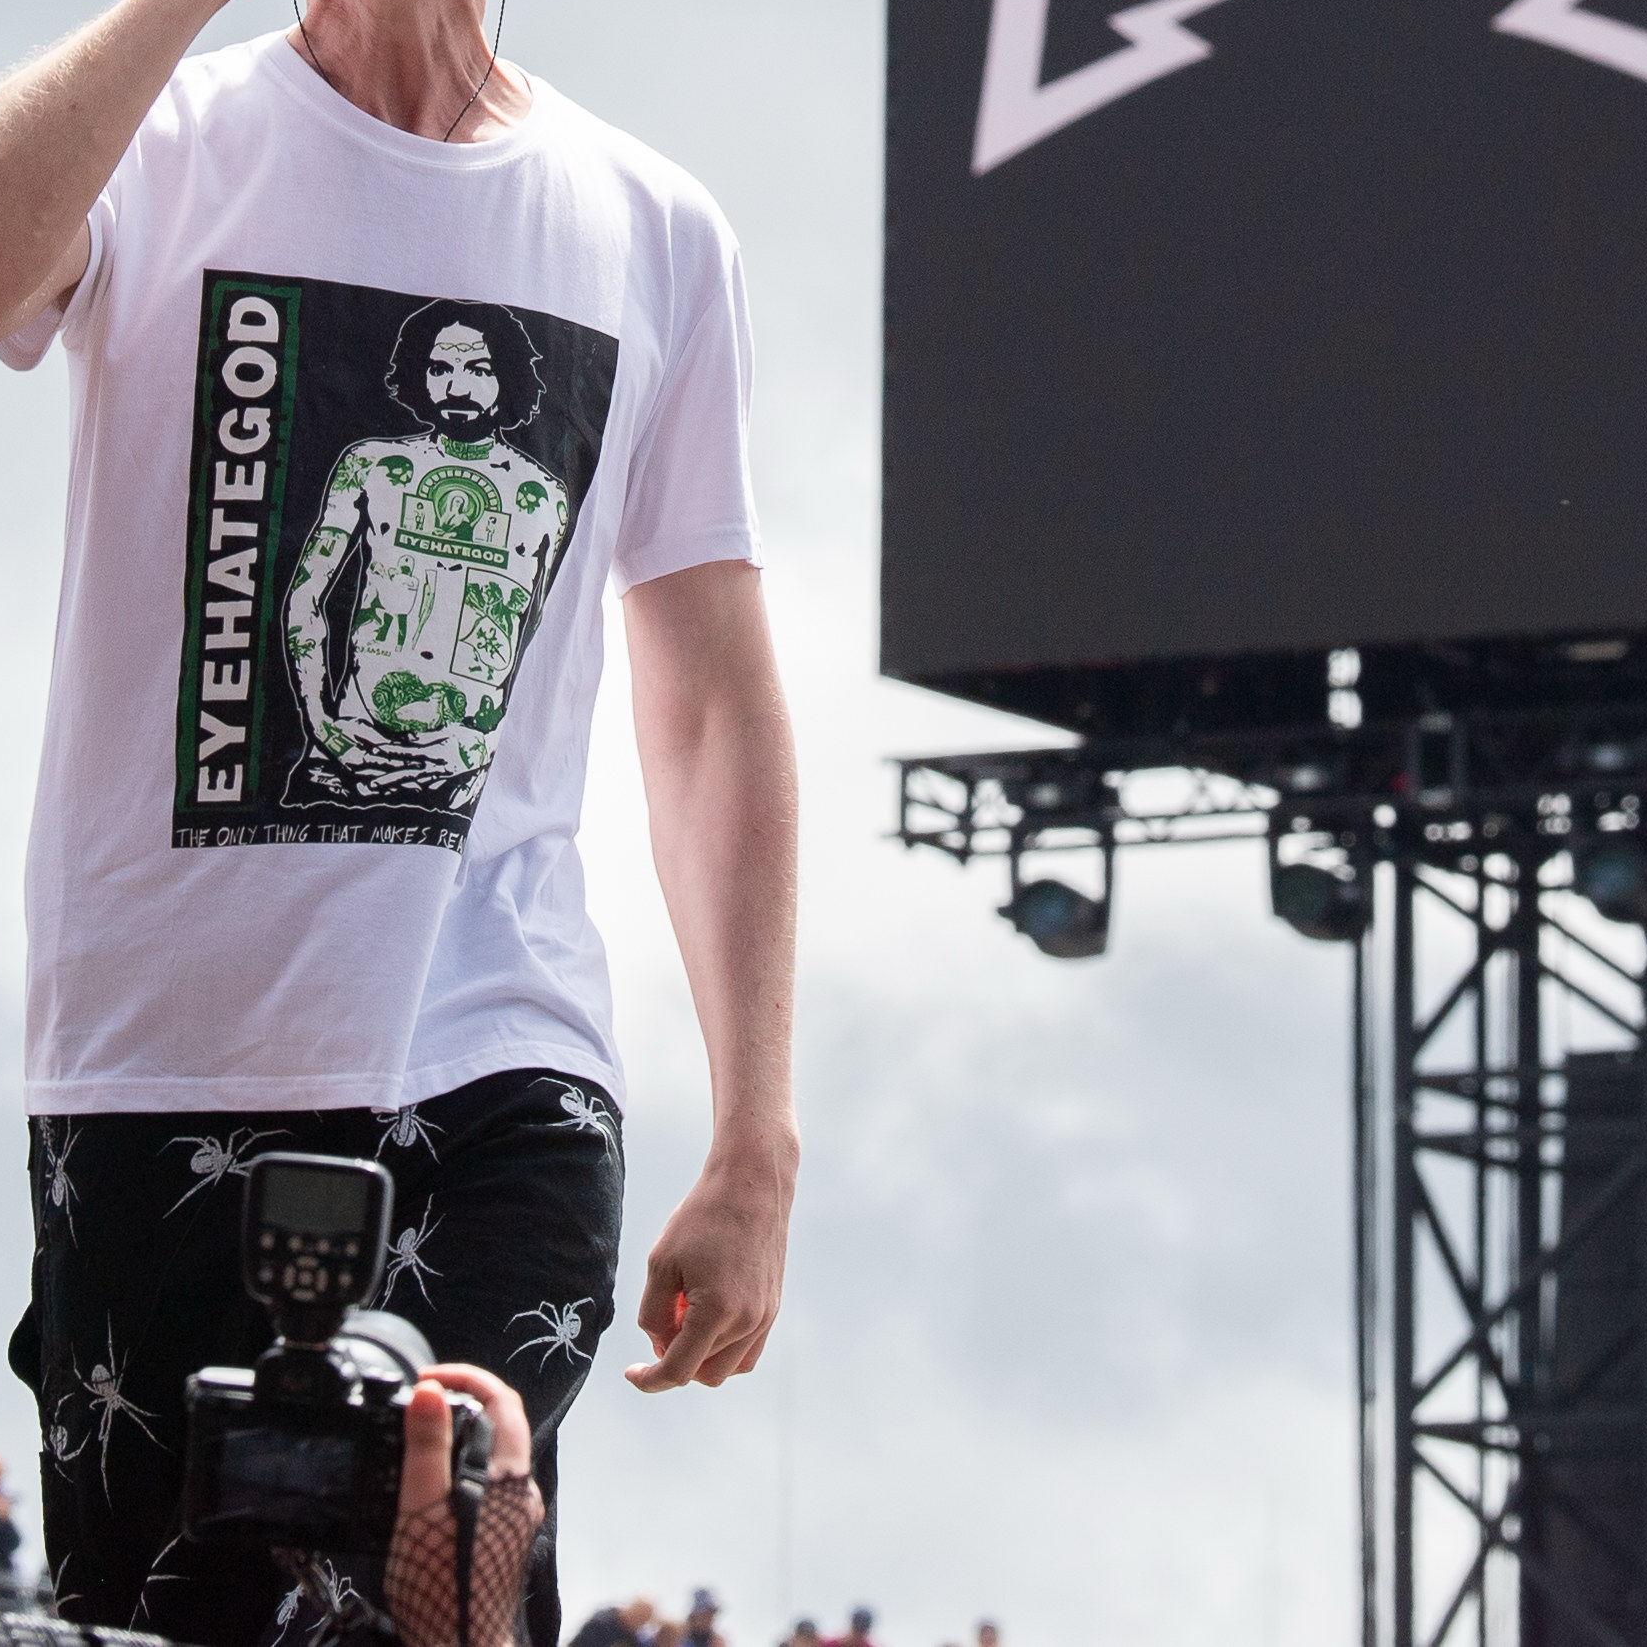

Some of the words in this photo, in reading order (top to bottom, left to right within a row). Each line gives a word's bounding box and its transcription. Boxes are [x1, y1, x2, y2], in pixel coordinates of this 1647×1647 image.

[197, 295, 280, 803] EYEHATEGOD
[399, 534, 504, 564] EYEHATEGOD
[175, 827, 211, 847] THE
[216, 825, 258, 845] ONLY
[264, 823, 310, 842] THING
[317, 823, 363, 842] THAT
